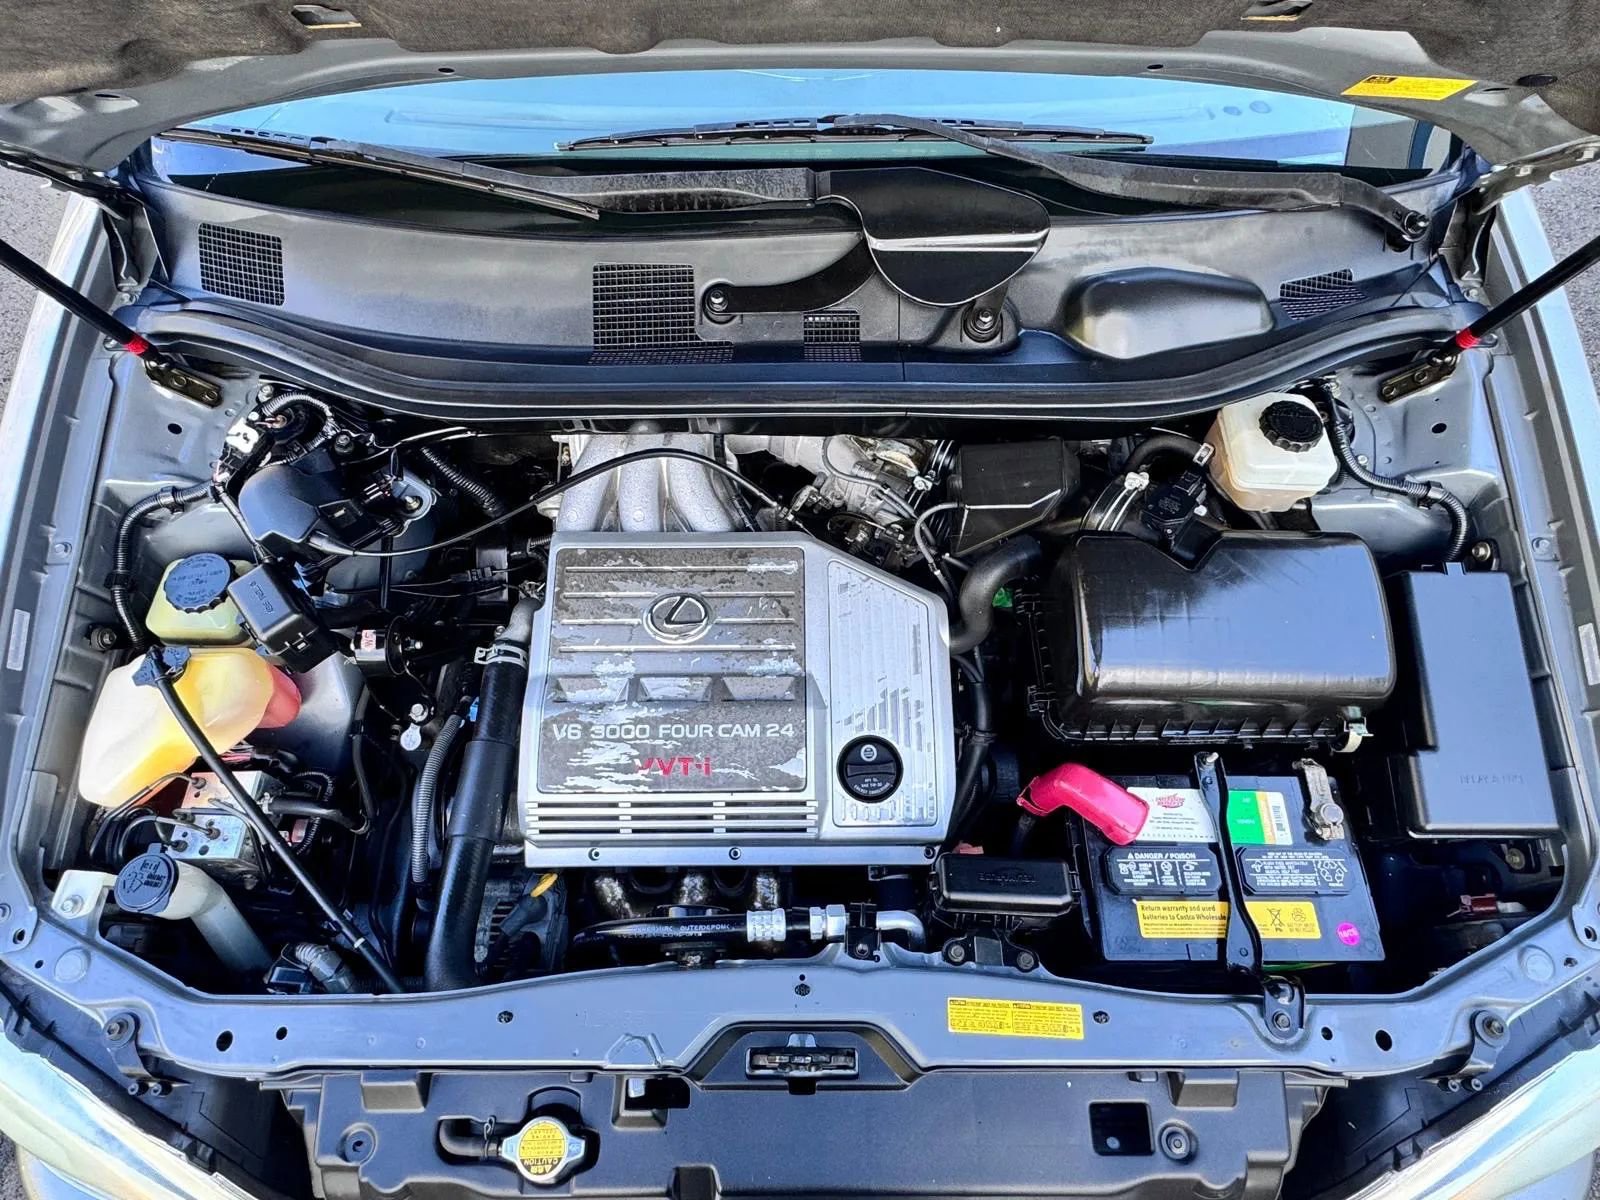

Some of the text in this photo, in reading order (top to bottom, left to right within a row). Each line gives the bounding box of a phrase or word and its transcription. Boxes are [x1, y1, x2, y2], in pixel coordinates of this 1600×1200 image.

[552, 724, 795, 740] V6 3000 FOUR CAM 24
[634, 757, 712, 776] VVT-i
[1134, 852, 1164, 860] DANGER
[1170, 852, 1197, 860] POISON
[1162, 905, 1188, 913] warranty
[1189, 904, 1201, 912] and
[1201, 904, 1216, 912] used
[1196, 912, 1227, 920] Wholesale
[524, 1158, 558, 1166] CAUTION
